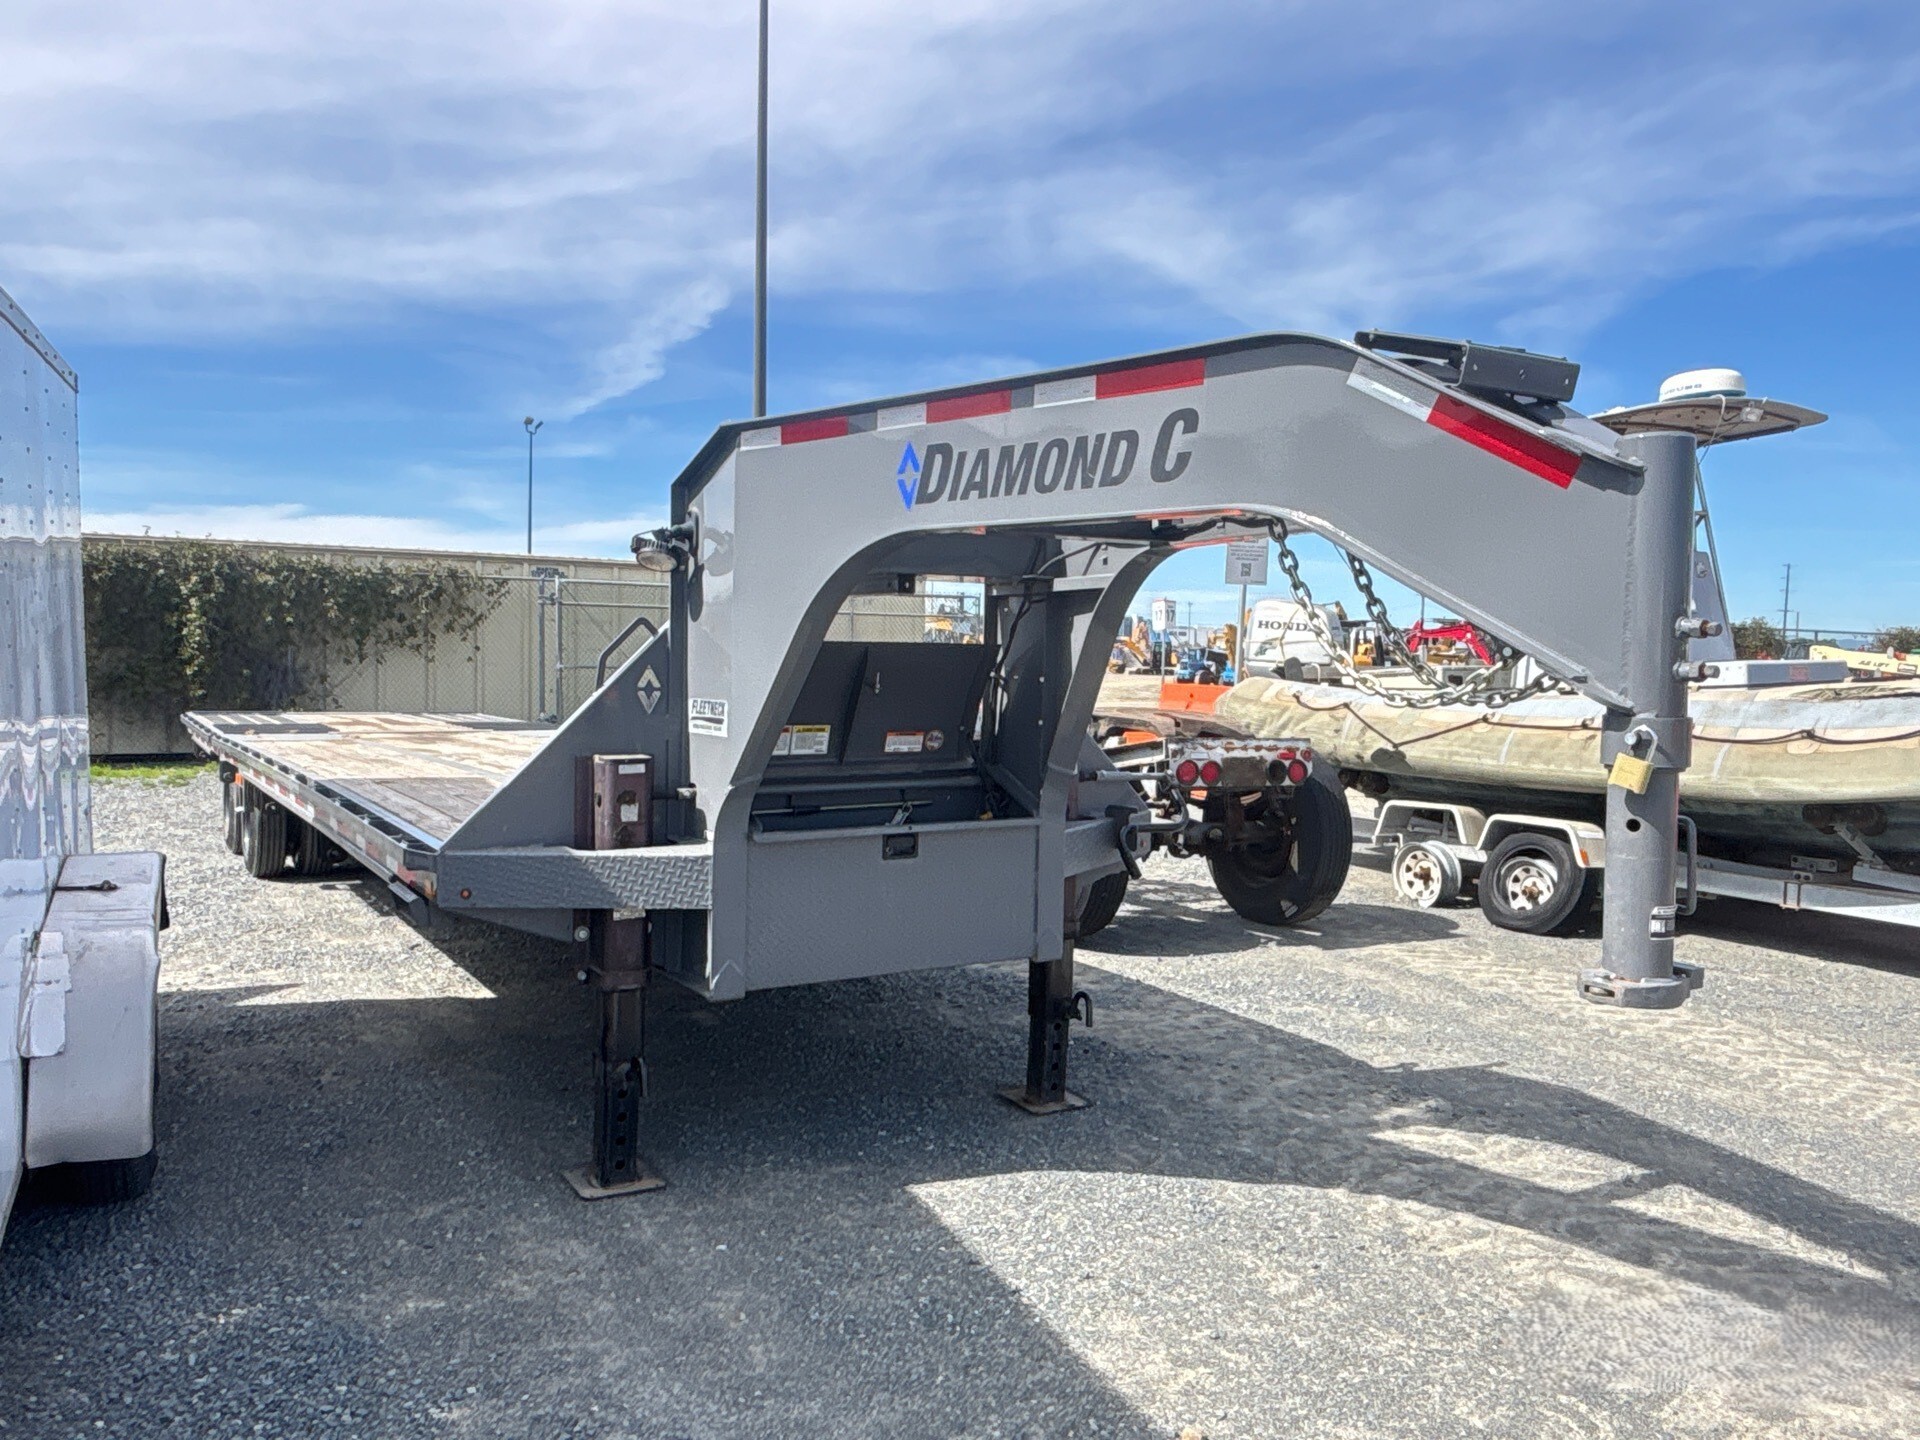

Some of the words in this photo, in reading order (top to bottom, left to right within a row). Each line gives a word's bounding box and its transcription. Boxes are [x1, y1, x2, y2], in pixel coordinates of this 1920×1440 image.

[915, 429, 1139, 505] DIAMOND
[1149, 407, 1200, 483] C
[1166, 609, 1175, 622] 17
[691, 699, 726, 717] FLEETNECK
